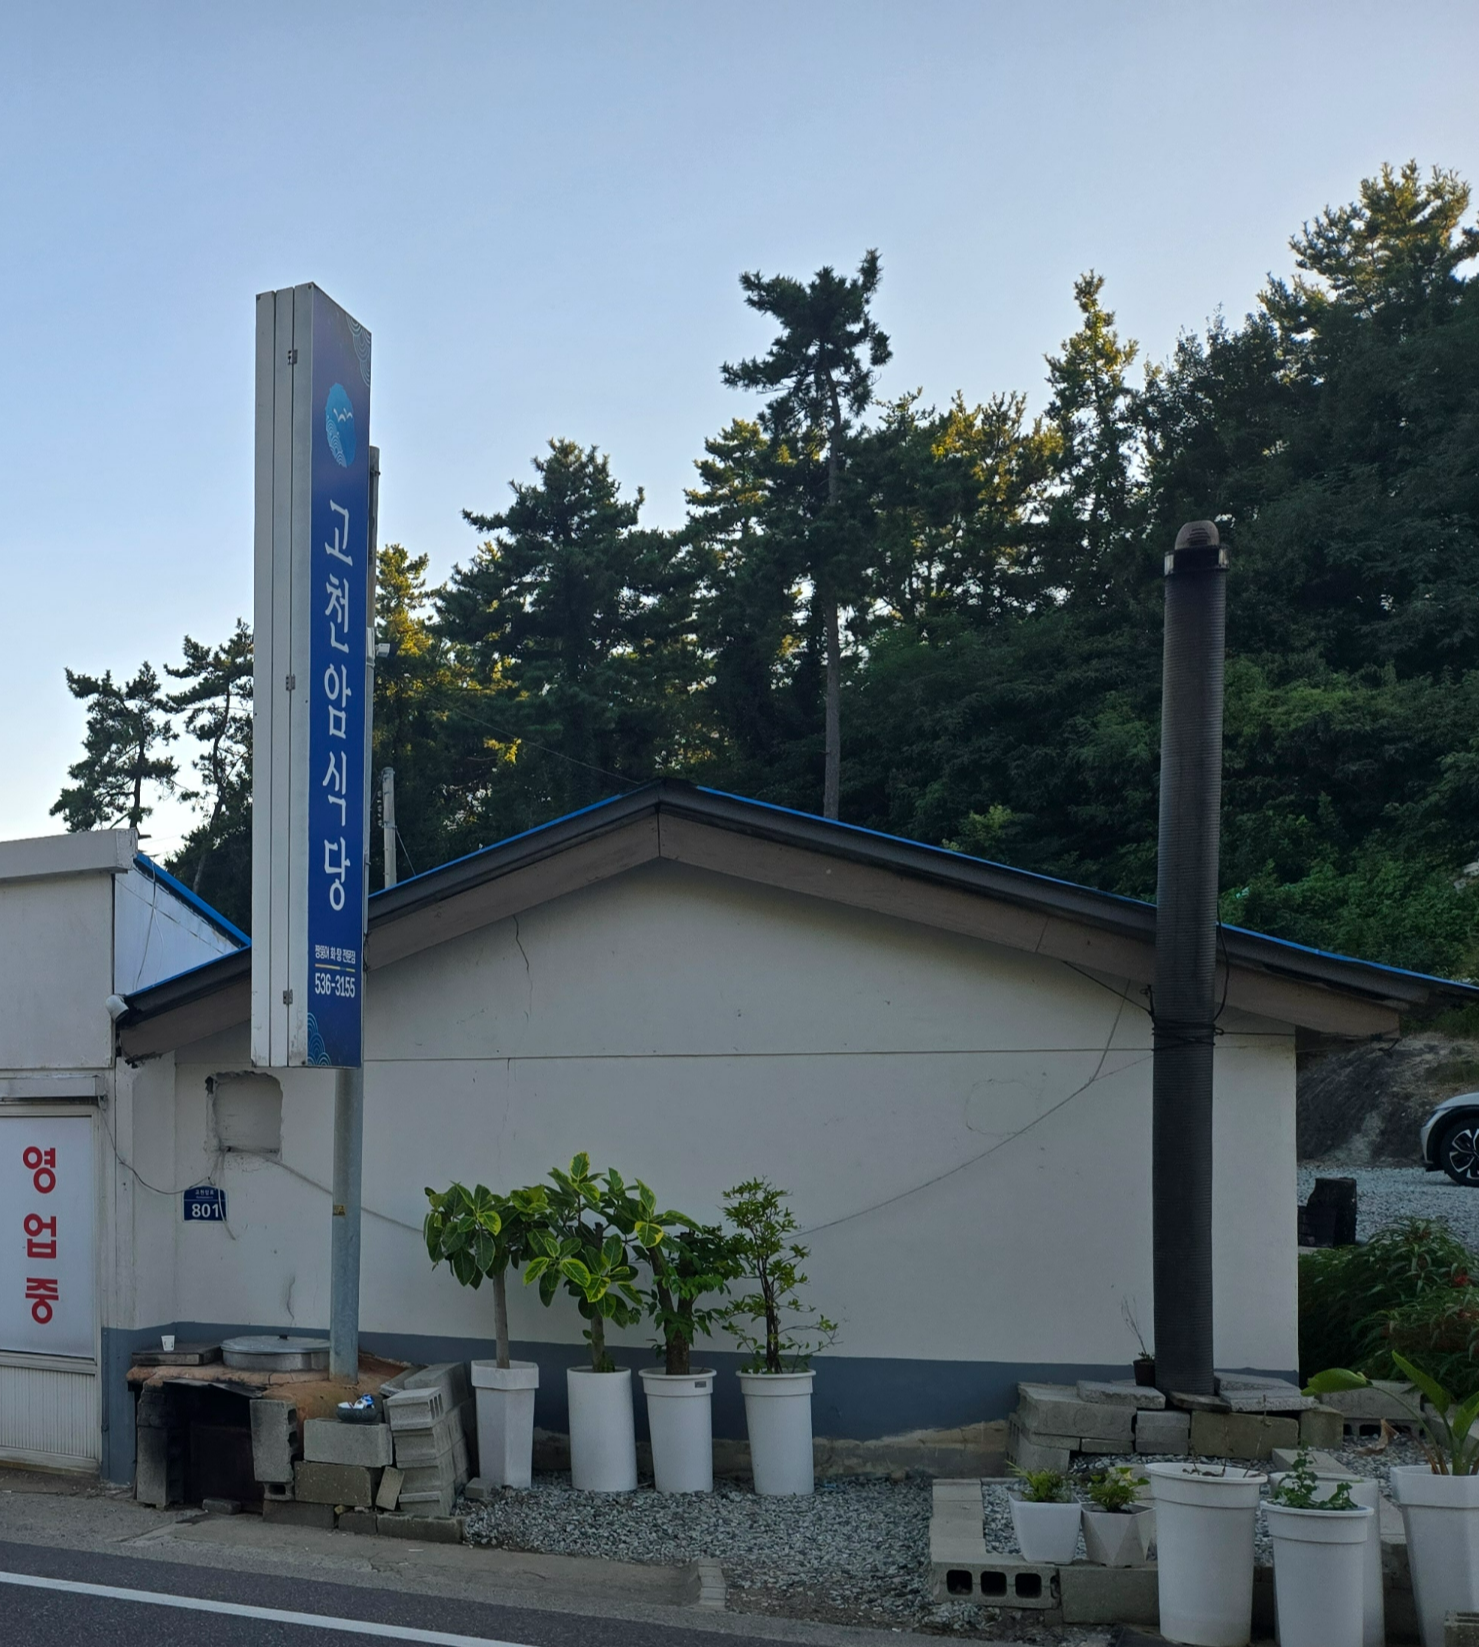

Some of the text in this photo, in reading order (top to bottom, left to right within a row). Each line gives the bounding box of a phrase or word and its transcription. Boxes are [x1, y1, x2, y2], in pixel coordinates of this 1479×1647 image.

[323, 498, 354, 912] 고천암식당
[314, 972, 356, 999] 536-3155
[191, 1203, 219, 1218] 801
